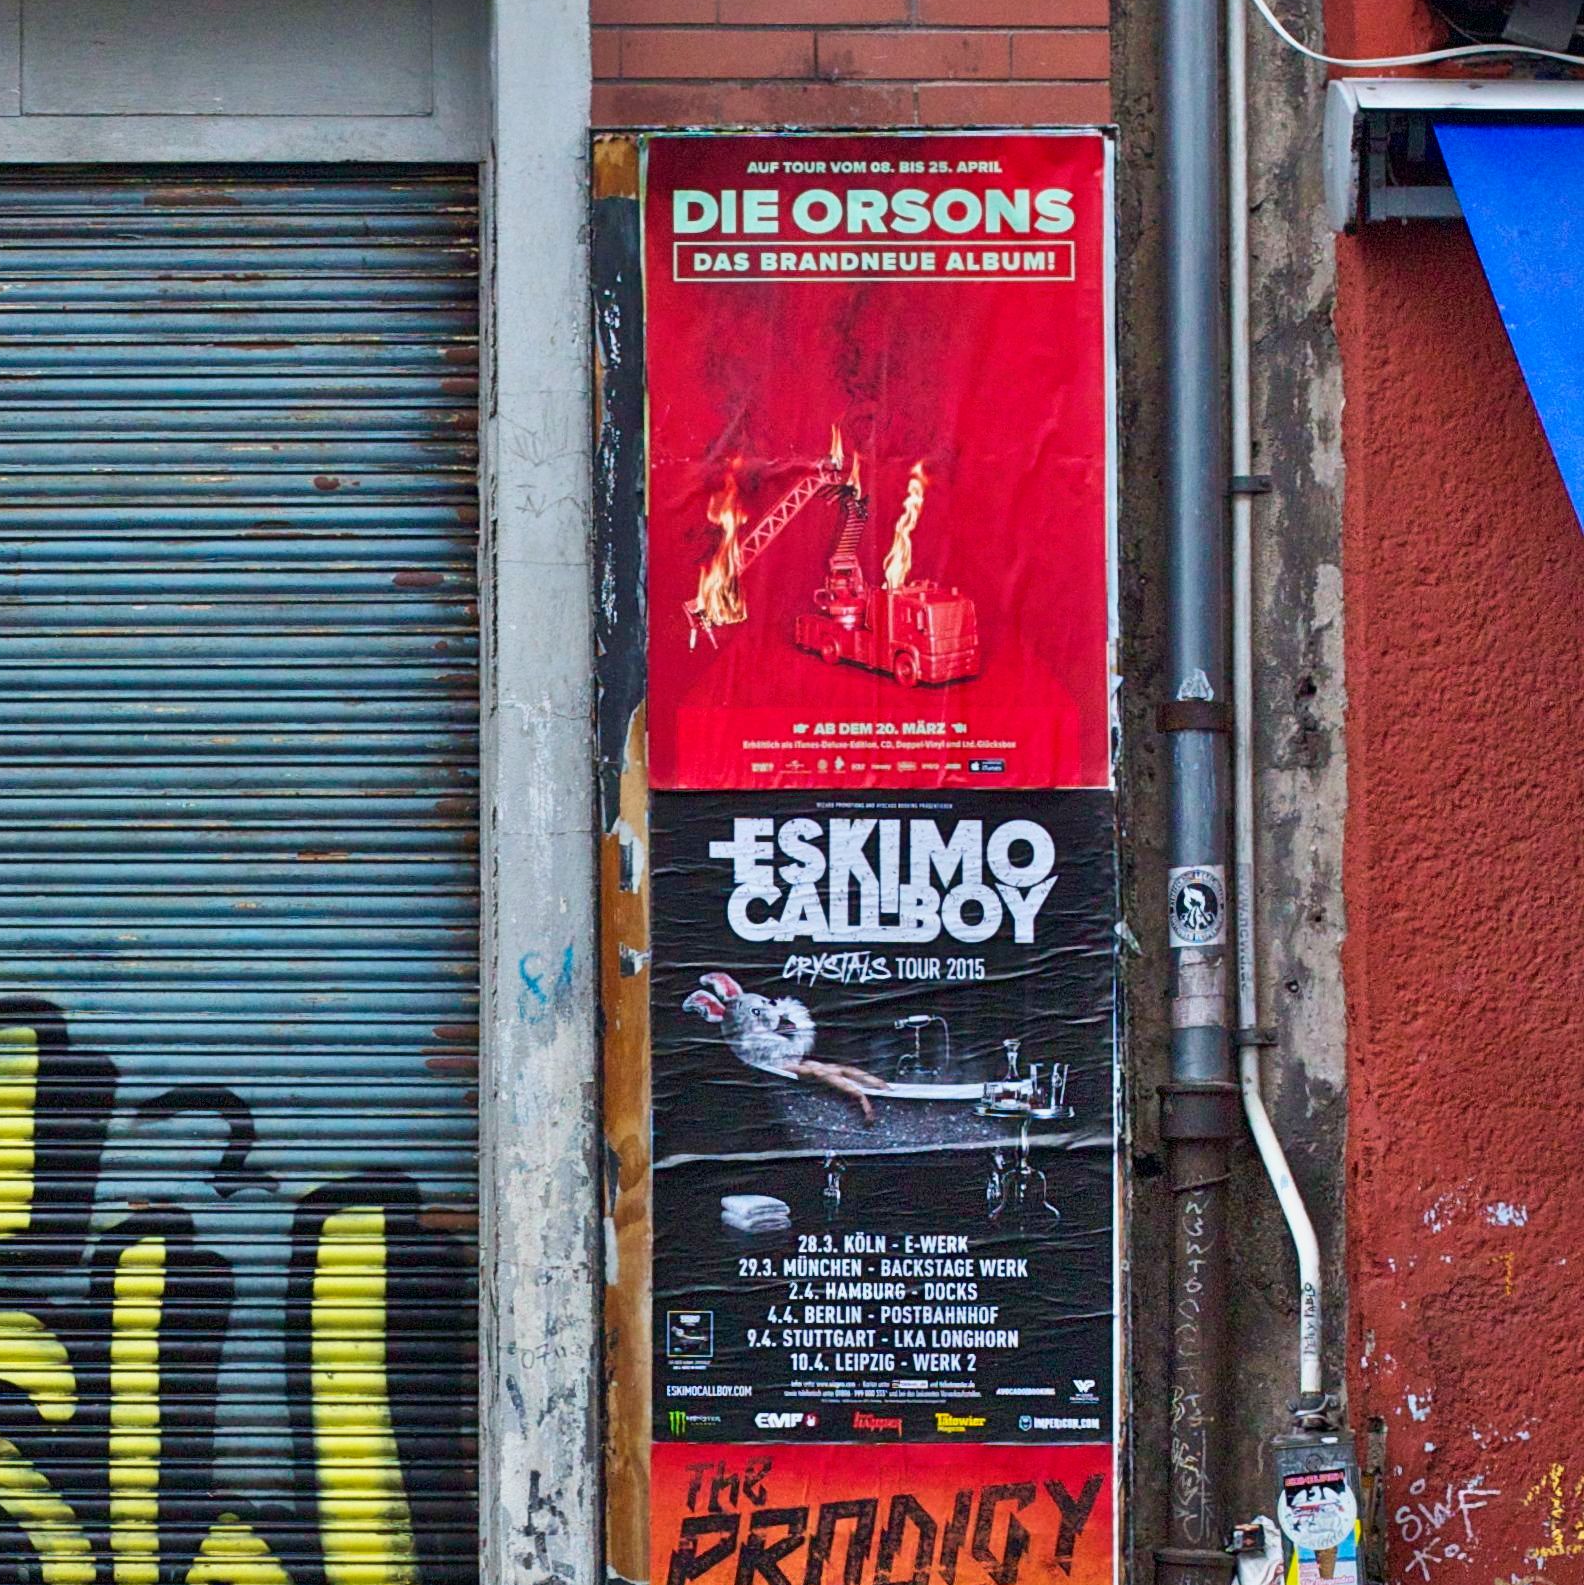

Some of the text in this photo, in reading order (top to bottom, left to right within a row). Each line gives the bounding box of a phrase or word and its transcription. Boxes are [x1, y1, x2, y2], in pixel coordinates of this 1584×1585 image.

[747, 161, 1002, 174] AUF TOUR VOM 08. BIS 25. APRIL
[672, 188, 1075, 234] DIE ORSONS
[693, 252, 1056, 272] DAS BRANDNEUE ALBUM!
[814, 720, 946, 735] AB DEM 20. MÄRZ
[709, 818, 1056, 889] ESKIMO
[727, 875, 1059, 943] CALLBOY
[782, 951, 985, 985] CRYSTALS TOUR 2015
[798, 1232, 968, 1253] 28.3. KÖLN E-WERK
[739, 1256, 1028, 1277] 29.3. MÜNCHEN BACKSTAGE WERK
[789, 1283, 978, 1300] 2.4. HAMBURG DOCKS
[767, 1306, 999, 1324] 4.4. BERLIN POSTBAHNHOF
[747, 1329, 1019, 1348] 9.4. STUTTGART LKA LONGHORN
[790, 1353, 976, 1371] 10.4. LEIPZIG WERK 2
[666, 1385, 752, 1397] ESKIMOCALLBOY.COM
[754, 1413, 804, 1428] EMP
